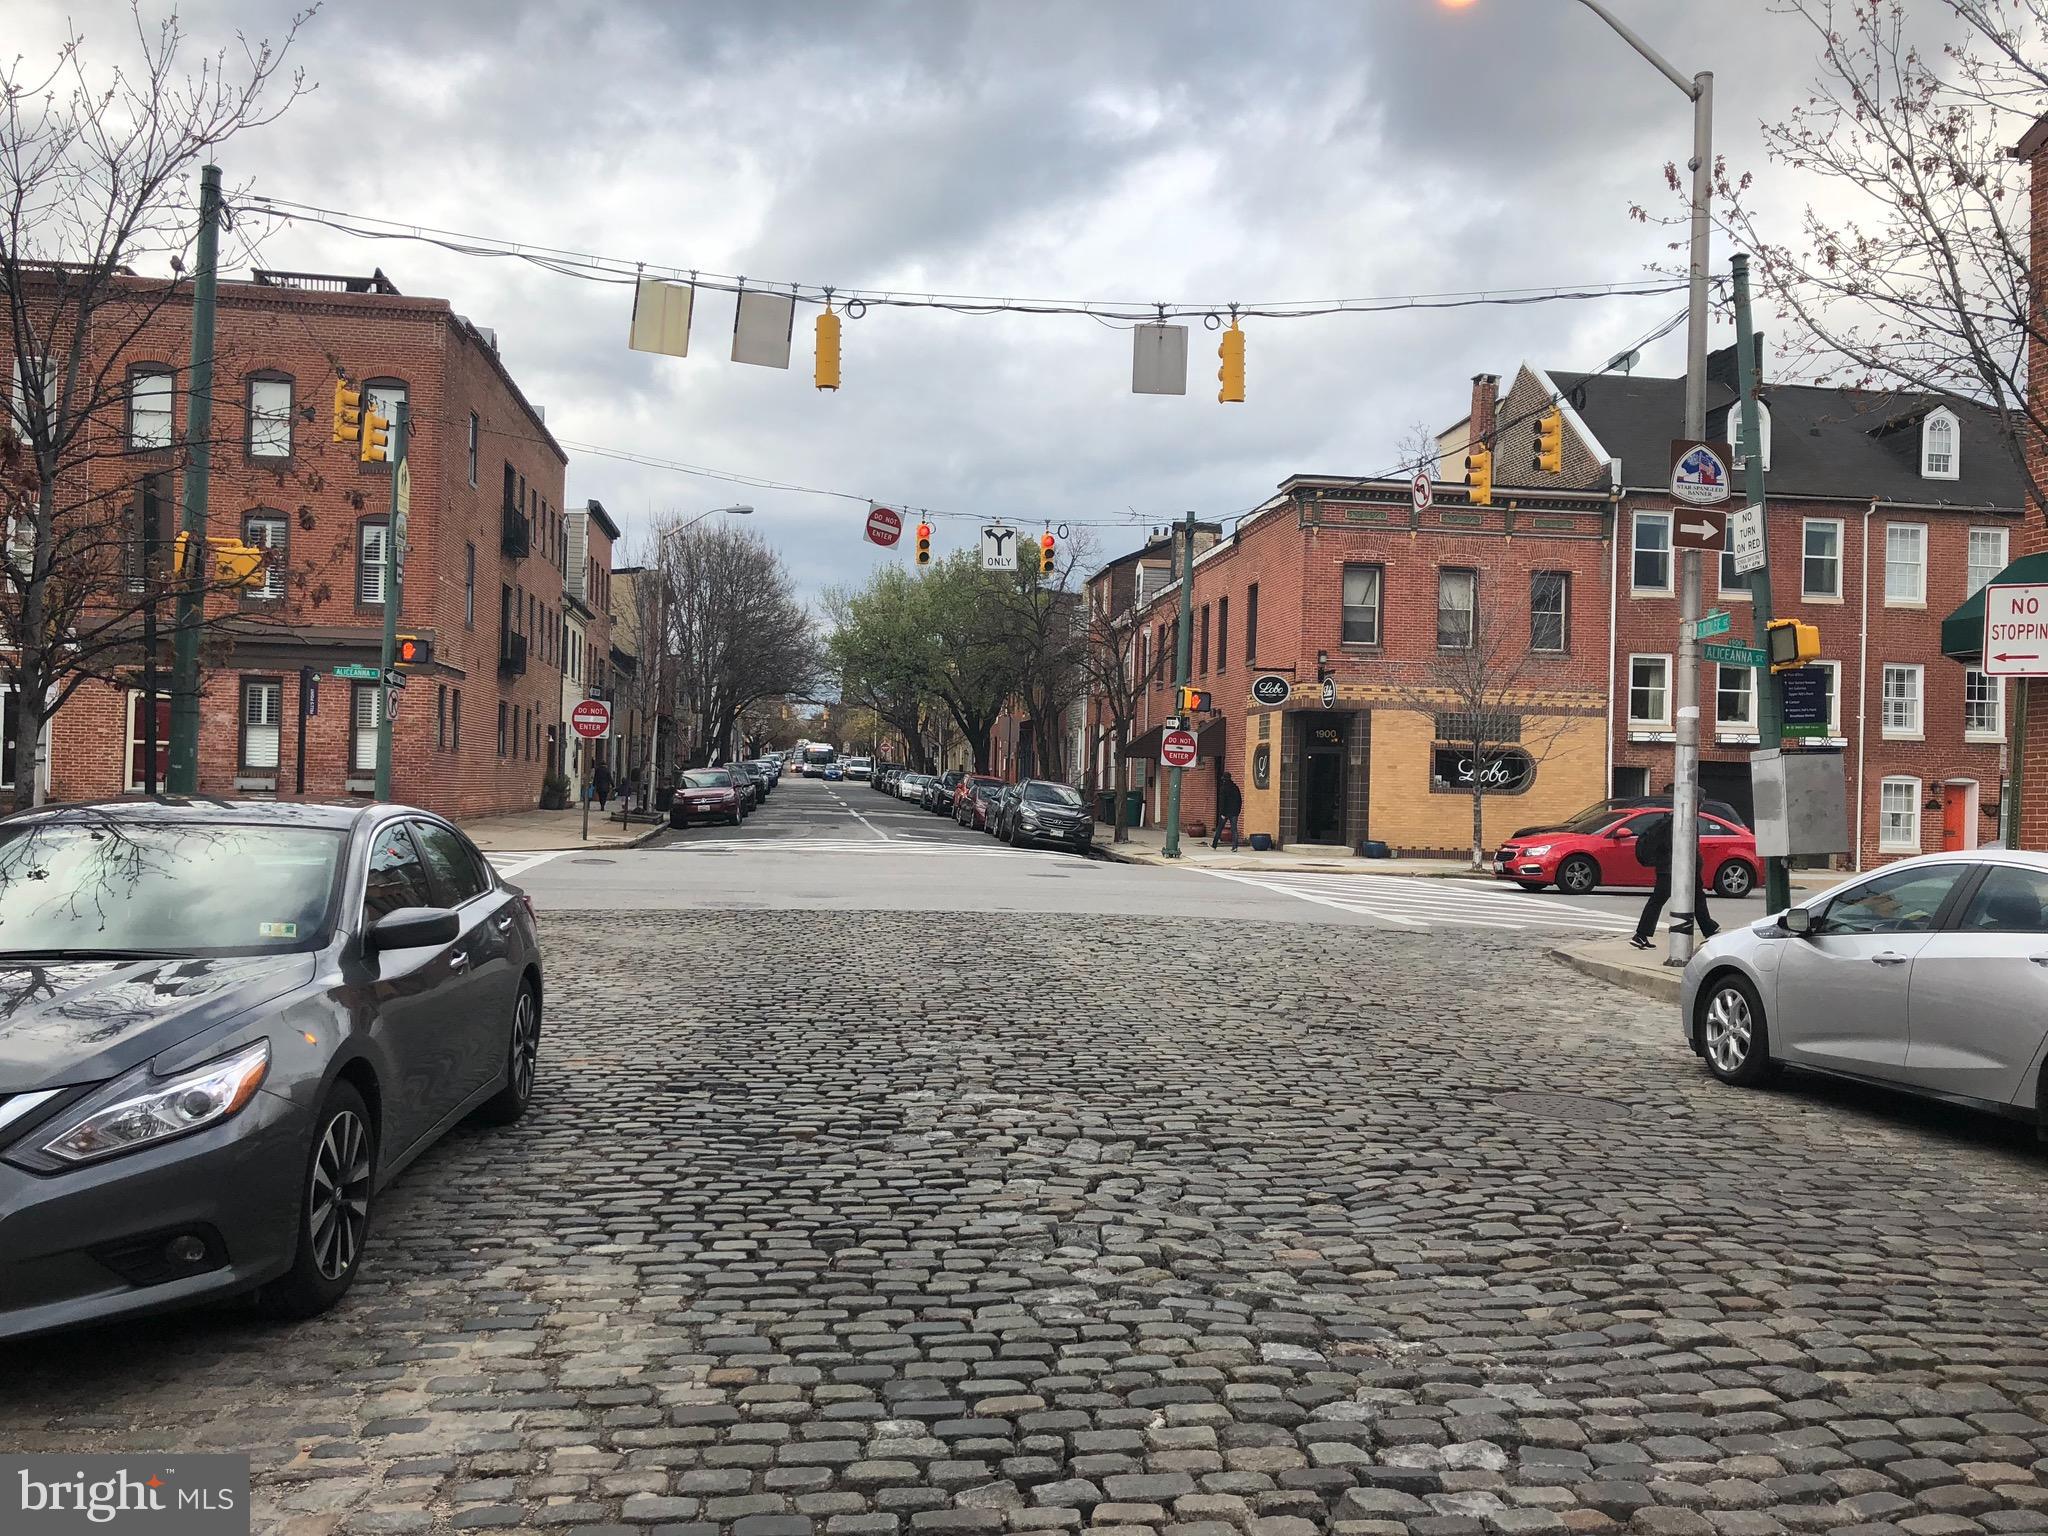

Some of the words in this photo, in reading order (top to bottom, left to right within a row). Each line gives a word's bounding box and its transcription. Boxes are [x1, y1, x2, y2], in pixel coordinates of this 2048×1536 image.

[874, 512, 883, 521] DO
[885, 516, 898, 526] NOT
[1742, 511, 1753, 523] NO
[872, 529, 893, 541] ENTER
[1740, 525, 1756, 538] TURN
[1736, 543, 1746, 554] ON
[1748, 538, 1760, 550] RED
[987, 557, 1012, 567] ONLY
[2011, 597, 2039, 615] NO
[1992, 623, 2048, 641] STOPPIN
[1706, 646, 1753, 664] ALICEANNA
[336, 668, 370, 677] ALICEANNA
[1259, 682, 1283, 694] Lobo
[579, 723, 601, 731] ENTER
[1315, 729, 1337, 738] 1900
[1169, 752, 1189, 760] ENTER
[1458, 758, 1509, 783] Lobo
